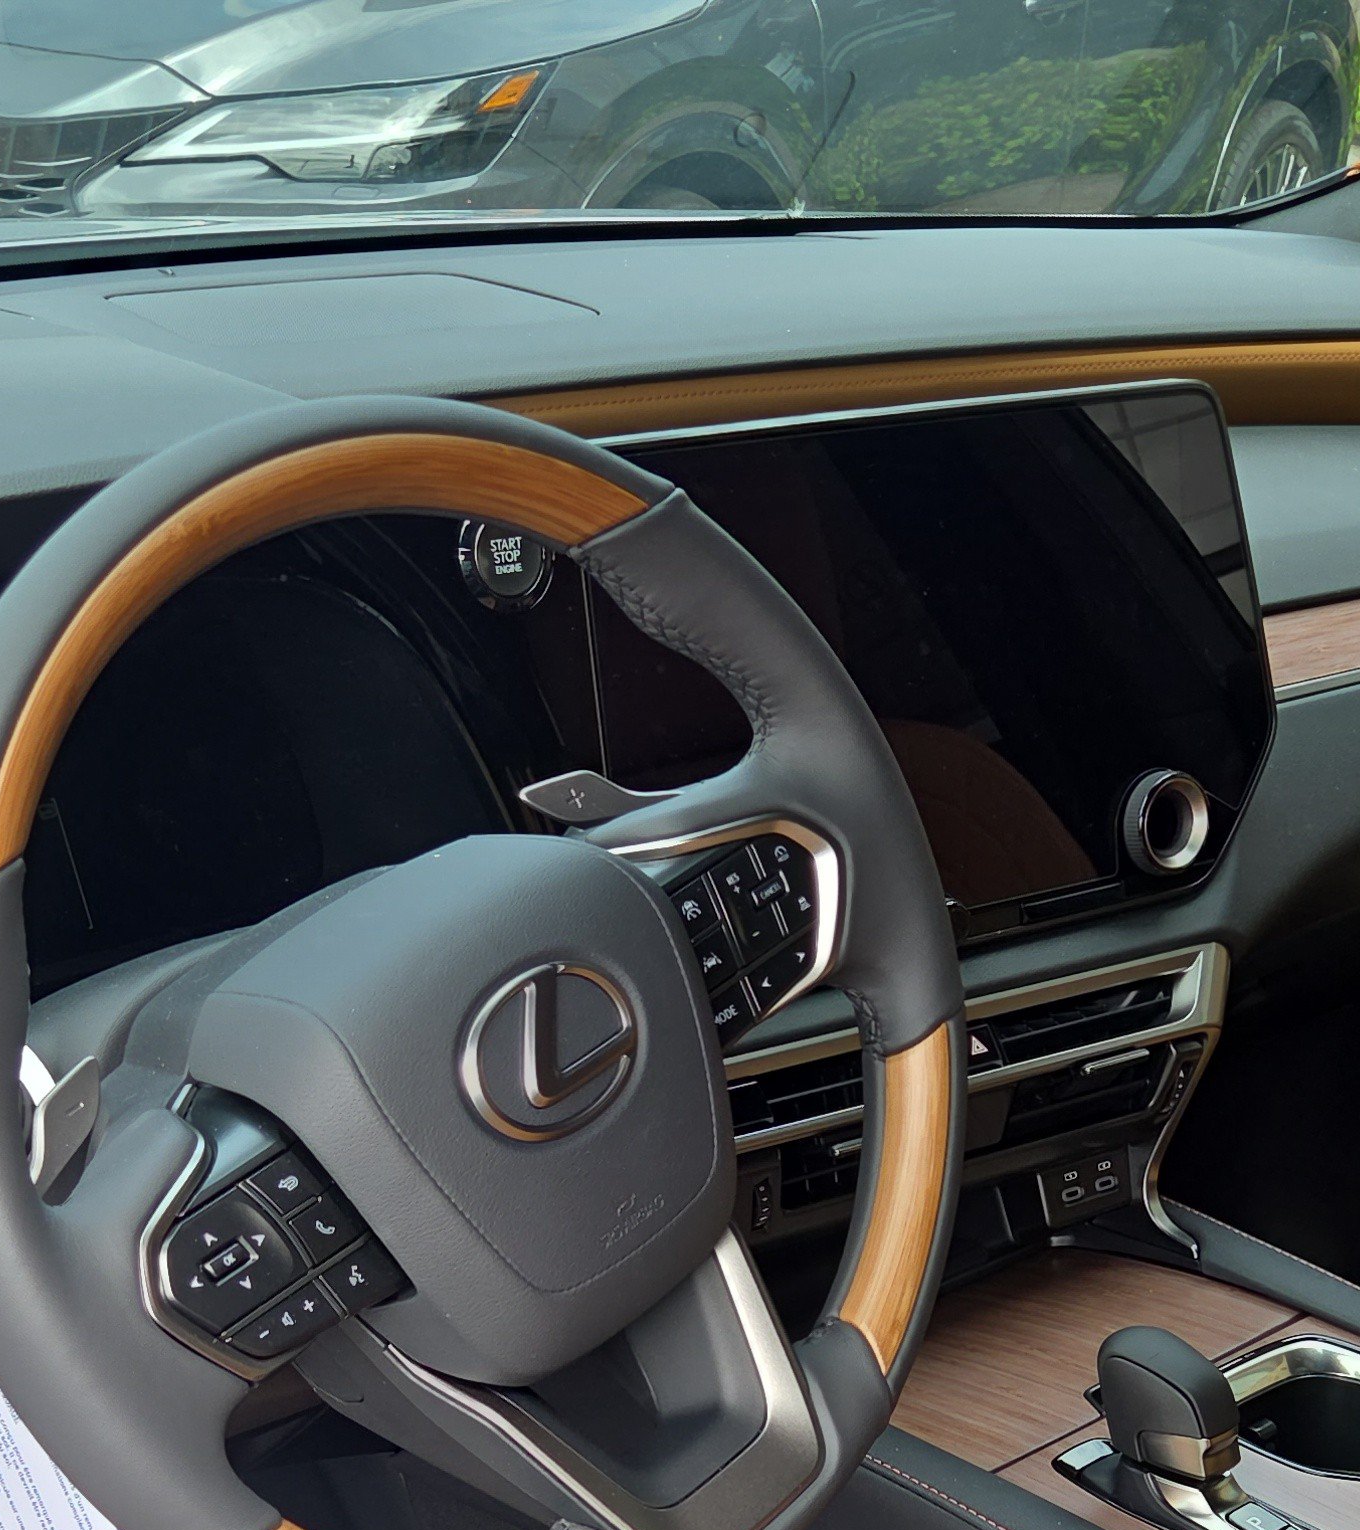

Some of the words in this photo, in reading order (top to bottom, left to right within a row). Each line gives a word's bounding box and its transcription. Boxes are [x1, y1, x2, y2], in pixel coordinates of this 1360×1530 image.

[490, 537, 522, 552] START
[494, 550, 520, 564] STOP
[495, 563, 523, 574] ENGINE
[0, 1419, 14, 1444] conçu
[12, 1446, 24, 1464] pour
[23, 1467, 32, 1483] être
[31, 1485, 51, 1524] remorqué
[18, 1471, 34, 1500] devrait
[32, 1501, 42, 1517] être
[9, 1500, 17, 1512] sur
[16, 1515, 24, 1530] une
